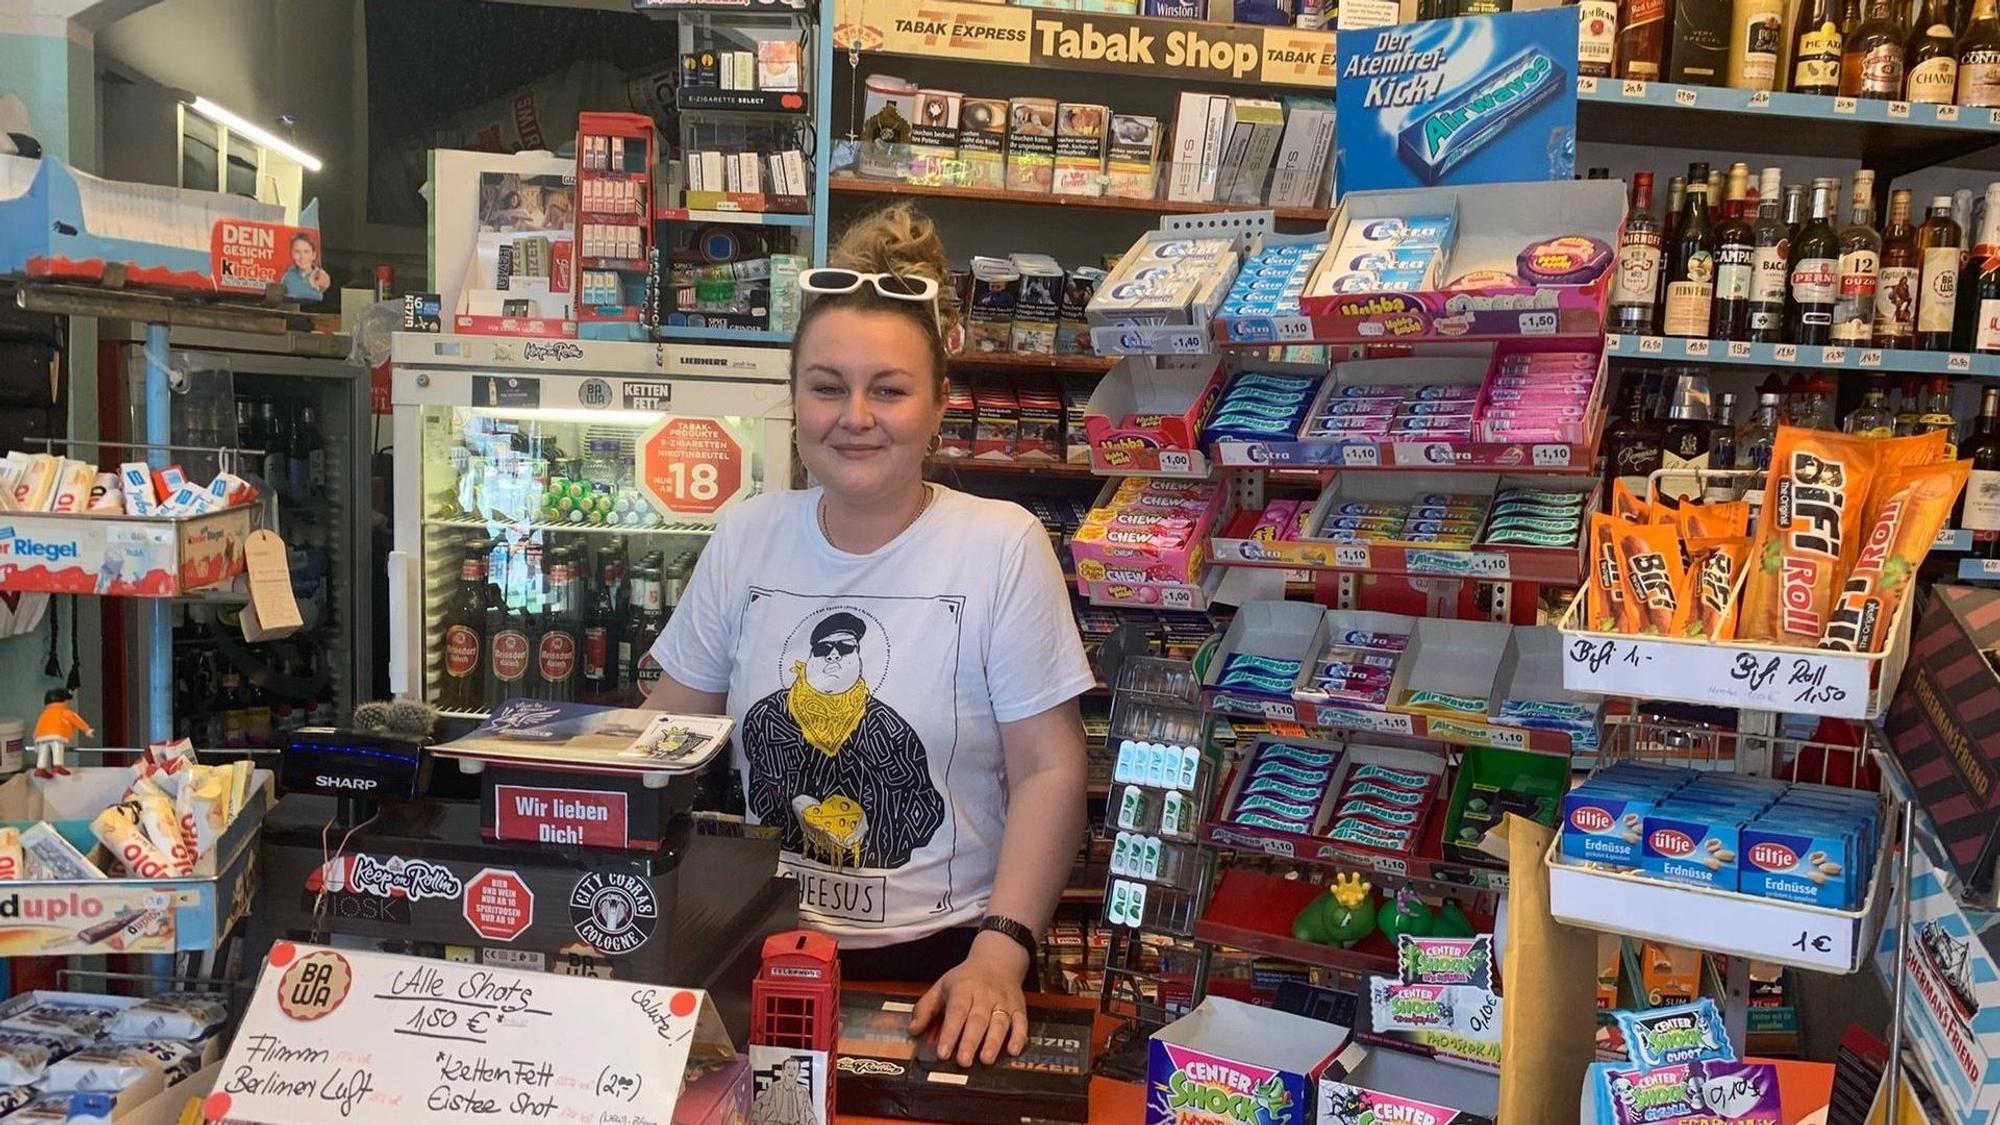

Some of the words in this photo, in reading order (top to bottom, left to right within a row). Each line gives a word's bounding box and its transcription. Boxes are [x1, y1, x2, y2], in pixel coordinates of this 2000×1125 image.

[1156, 4, 1194, 18] Winston
[895, 19, 947, 36] TABAK
[951, 24, 1027, 42] EXPRESS
[1035, 20, 1155, 64] Tabak
[1164, 24, 1258, 78] Shop
[1374, 31, 1412, 53] Der
[1267, 49, 1316, 65] TABAK
[1343, 50, 1448, 79] Atemfrei-
[1363, 73, 1444, 109] Kick!
[1423, 54, 1552, 160] Airwaves
[222, 223, 275, 248] DEIN
[1362, 218, 1436, 242] Extra
[223, 244, 274, 259] GESICHT
[222, 257, 276, 282] kinder
[1350, 250, 1424, 272] Extra
[1854, 258, 1873, 274] 12
[1332, 271, 1409, 293] Extra
[414, 297, 423, 309] 6
[1341, 297, 1404, 316] Hubba
[1234, 319, 1269, 336] Extra
[680, 356, 729, 367] LIEBHERR
[587, 384, 602, 394] BA
[624, 383, 669, 397] KETTEN
[1239, 374, 1308, 388] Airwaves
[633, 397, 659, 410] FETT
[1234, 388, 1301, 402] Airwaves
[1227, 402, 1294, 416] Airwaves
[1217, 416, 1288, 430] Airwaves
[669, 429, 719, 438] PRODUKTE
[661, 438, 727, 449] E-ZIGARETTEN
[657, 449, 730, 460] NIKOTINBEUTEL
[654, 476, 673, 484] NUR
[660, 484, 673, 493] AB
[668, 461, 719, 501] 18
[1151, 481, 1194, 490] CHEW
[1142, 496, 1184, 506] CHEW
[1506, 490, 1577, 502] Airwaves
[1502, 503, 1576, 515] Airwaves
[1118, 515, 1162, 524] CHEW
[1498, 516, 1573, 529] Airwaves
[1107, 532, 1154, 542] CHEW
[1494, 529, 1571, 542] Airwaves
[1857, 500, 1902, 571] Roll
[14, 538, 78, 562] Riegel
[1414, 553, 1471, 568] Airwaves
[1106, 571, 1147, 582] CHEW
[1783, 557, 1821, 637] Roll
[1235, 655, 1300, 673] Airwaves
[1788, 659, 1828, 687] Roll
[1229, 671, 1293, 689] Airwaves
[1794, 686, 1847, 703] 1,50
[1914, 668, 1961, 749] FISHERMAN'S
[1954, 734, 1990, 797] FRIEND
[315, 774, 378, 791] SHARP
[515, 795, 548, 818] Wir
[553, 797, 608, 821] lieben
[1576, 809, 1609, 830] ültje
[539, 823, 584, 845] Dich!
[1653, 832, 1690, 852] ültje
[1584, 838, 1631, 855] Erdnüsse
[1754, 845, 1792, 867] ültje
[353, 856, 392, 890] Keep
[408, 858, 460, 897] Rollin
[1663, 862, 1713, 881] Erdnüsse
[491, 878, 508, 888] BIER
[576, 872, 605, 904] CITY
[1764, 877, 1818, 896] Erdnüsse
[481, 896, 495, 905] NUR
[498, 889, 517, 898] WEIN
[782, 871, 873, 914] HEESUS
[0, 893, 104, 922] duplo
[475, 904, 521, 918] SPIRITUOSEN
[480, 914, 494, 923] NUR
[581, 925, 639, 950] COLOGNE
[1791, 930, 1833, 953] 1€
[1425, 946, 1462, 957] CENTER
[300, 962, 333, 984] BA
[290, 982, 332, 1008] WA
[391, 965, 445, 997] Alle
[458, 972, 533, 1013] Shots
[1397, 988, 1434, 1001] CENTER
[1649, 988, 1662, 1005] 6
[407, 1006, 458, 1032] 1,50
[632, 989, 693, 1048] Salute!
[1906, 946, 1950, 1028] SHERMAN'S
[1945, 1016, 1980, 1083] FRIEND
[1653, 1017, 1692, 1033] CENTER
[512, 1060, 554, 1088] Fett
[1185, 1061, 1251, 1091] CENTER
[1639, 1073, 1677, 1087] CENTER
[224, 1064, 317, 1098] Berliner
[320, 1068, 374, 1118] Luft
[1168, 1068, 1258, 1122] SHOCK
[427, 1085, 501, 1114] Eistee
[510, 1092, 559, 1117] Shot
[1374, 1102, 1436, 1125] CENTER
